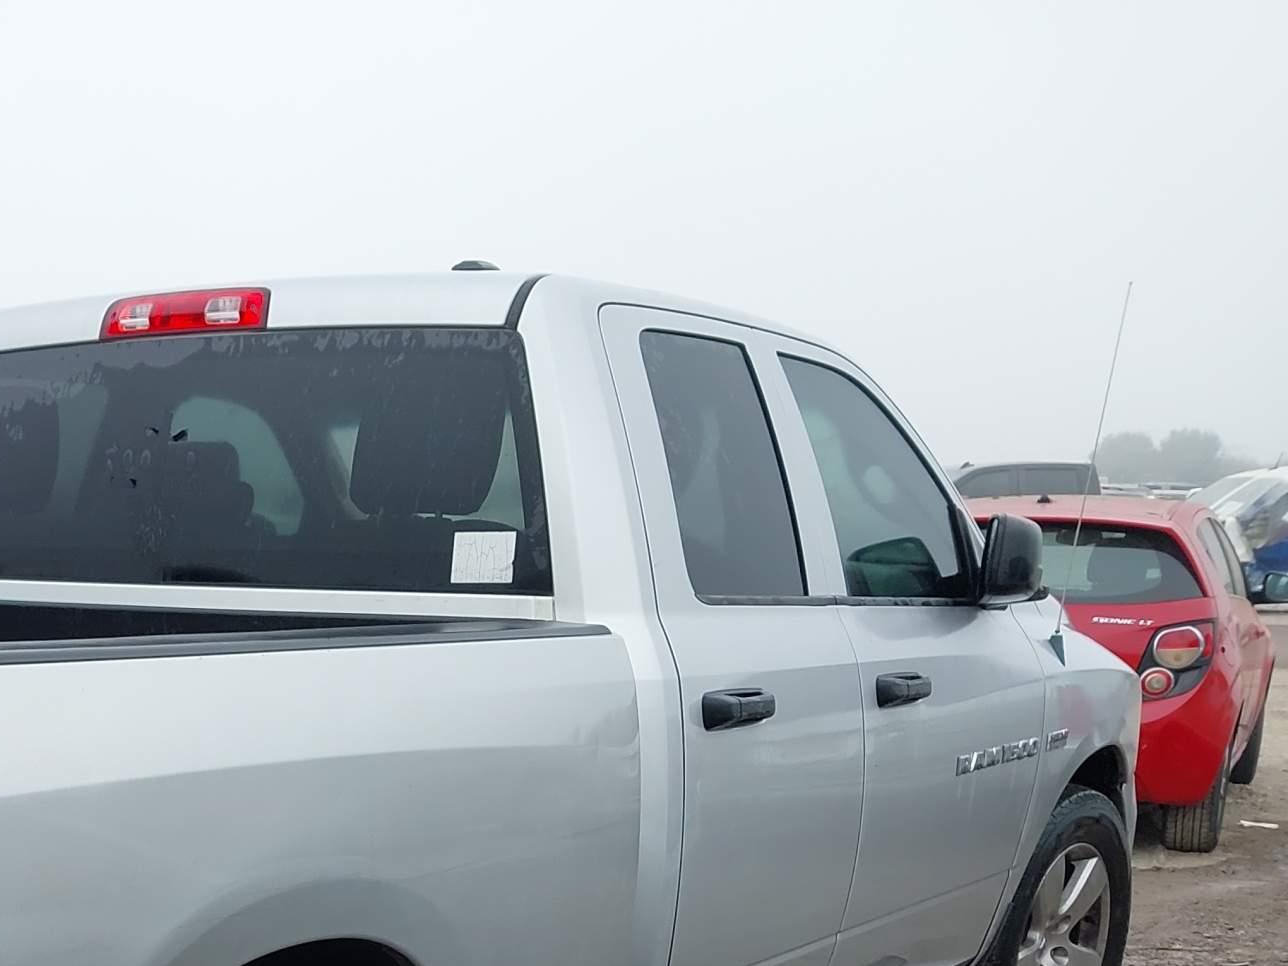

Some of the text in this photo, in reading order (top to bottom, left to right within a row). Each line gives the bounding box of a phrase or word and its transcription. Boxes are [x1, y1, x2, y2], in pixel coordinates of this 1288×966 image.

[1091, 615, 1155, 626] SONIC LT
[955, 747, 1001, 777] RAM
